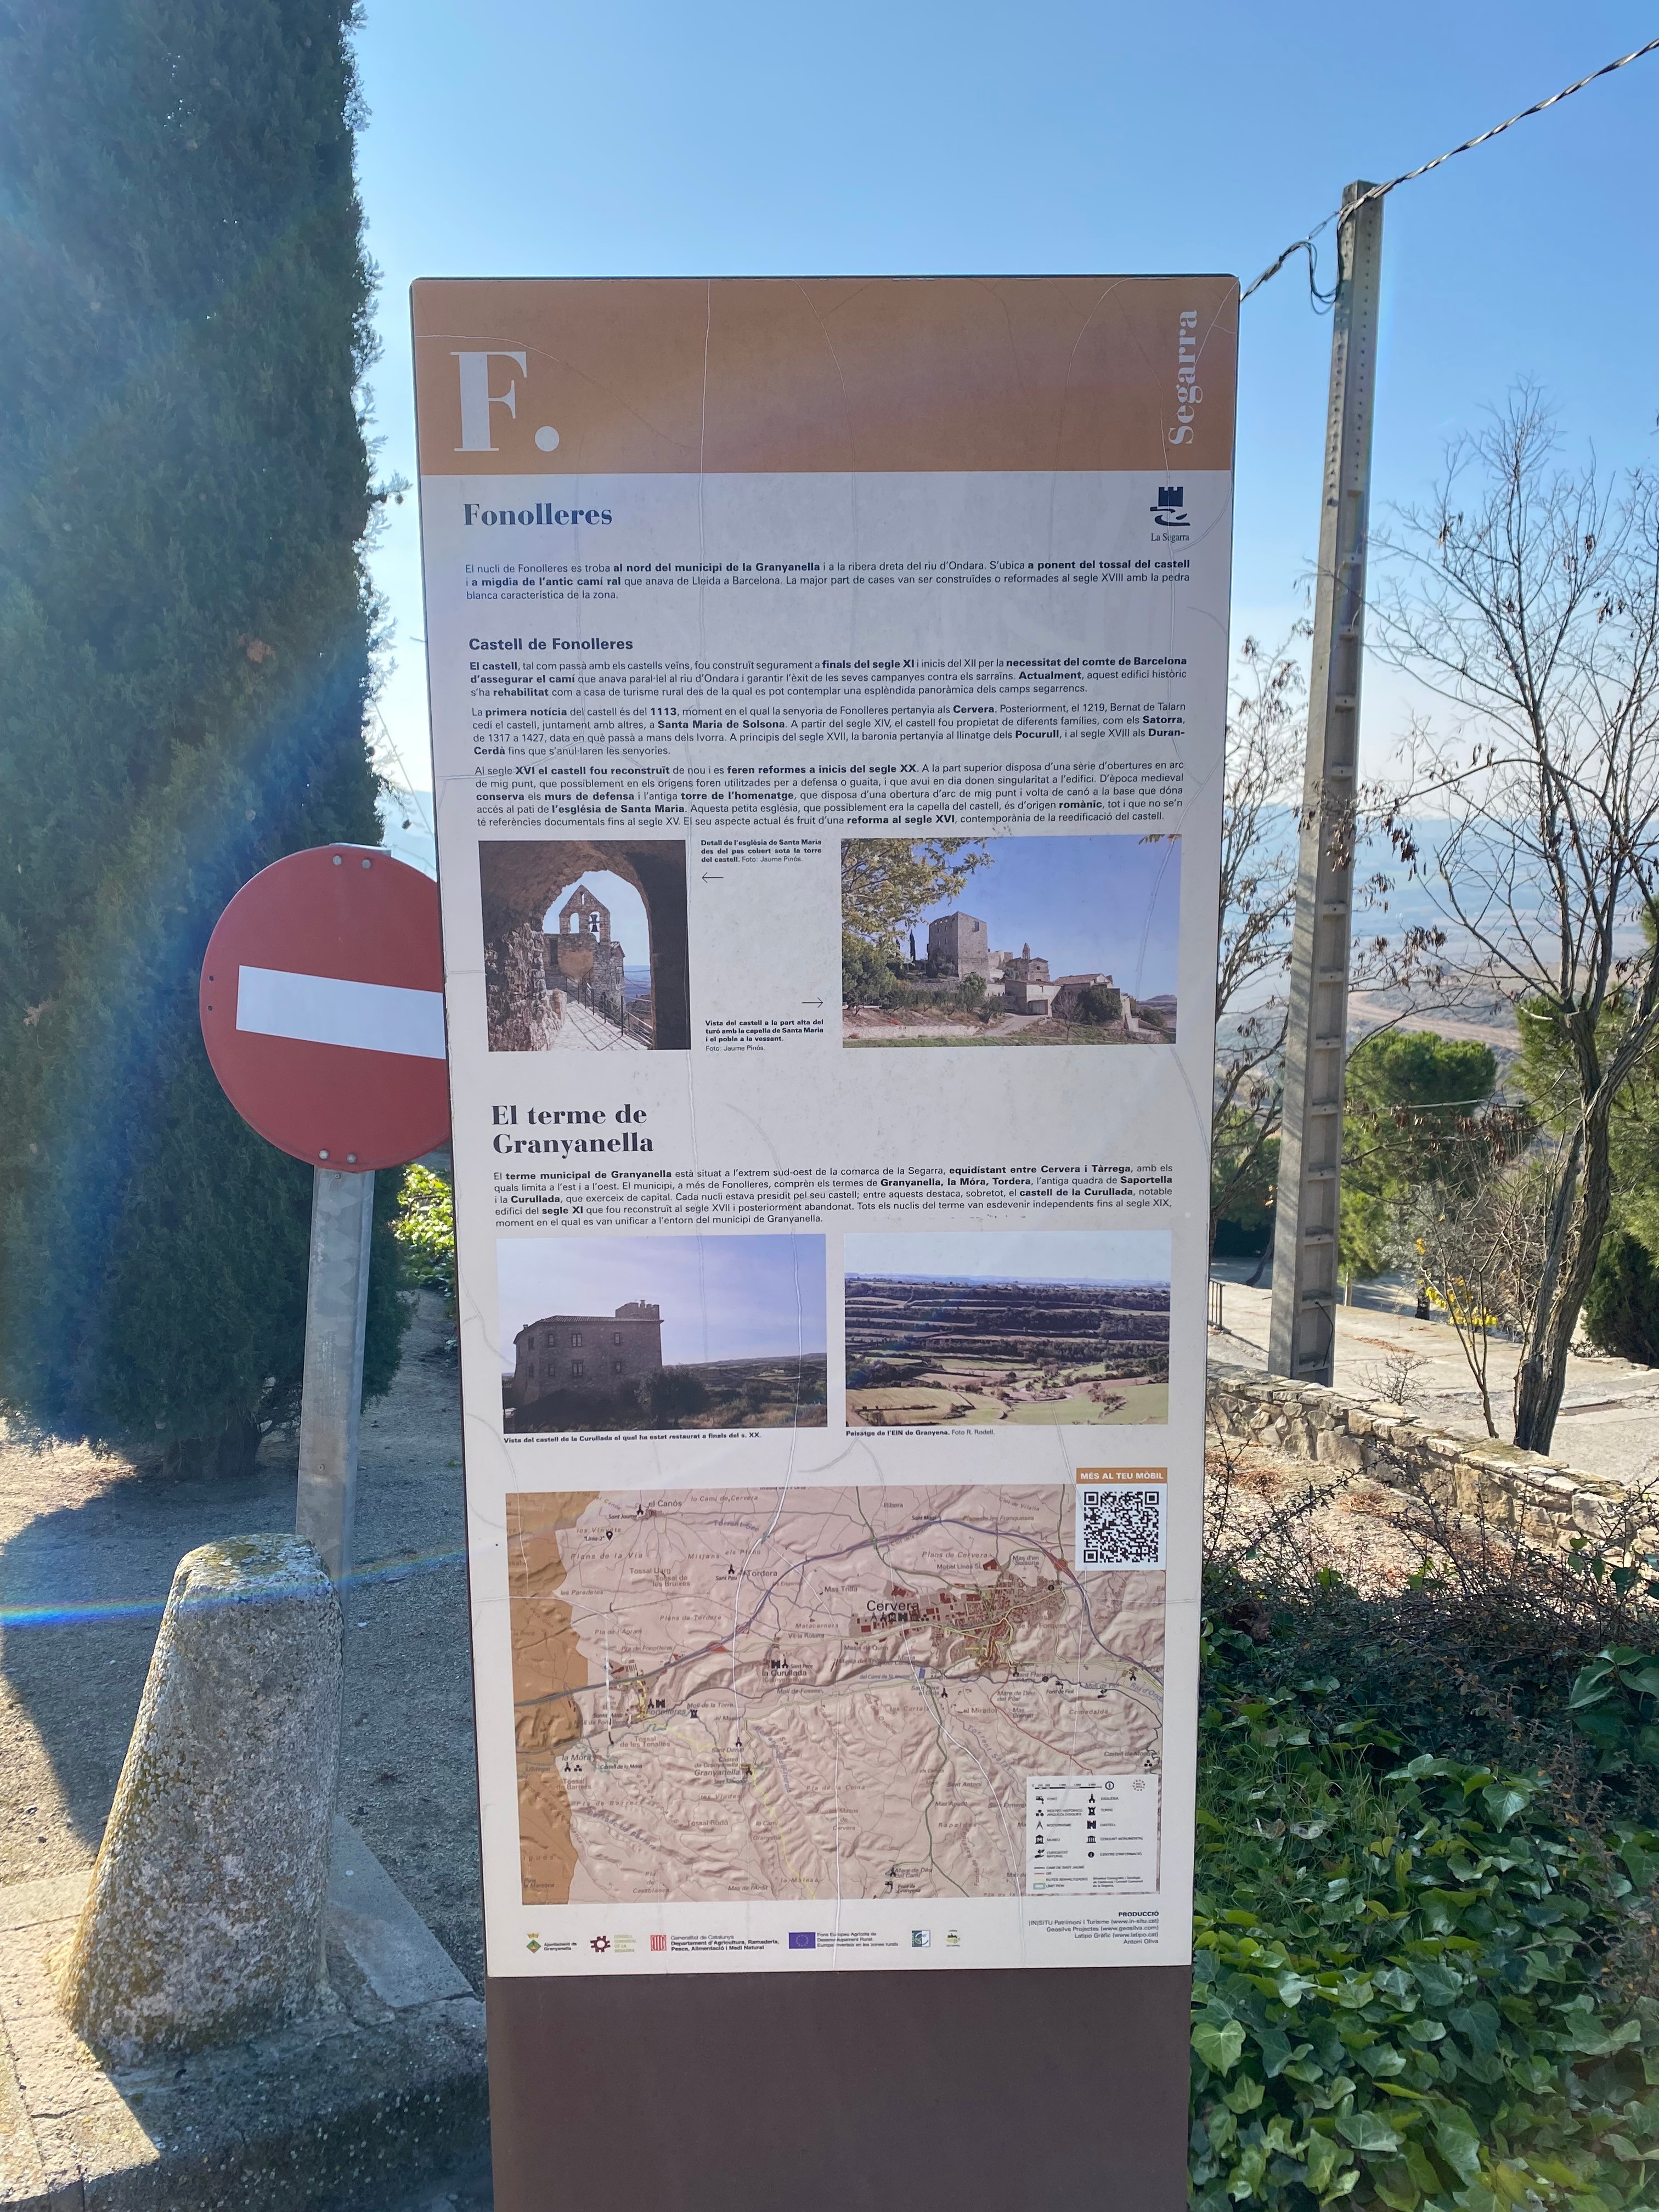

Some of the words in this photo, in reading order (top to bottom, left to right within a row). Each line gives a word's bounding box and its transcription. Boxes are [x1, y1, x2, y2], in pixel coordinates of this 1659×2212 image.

[1168, 309, 1203, 444] Segarra
[450, 351, 560, 452] F.
[463, 503, 612, 526] Fonolleres
[1151, 533, 1160, 541] La
[1163, 533, 1189, 543] Segarra
[465, 564, 474, 573] El
[477, 564, 500, 573] nucli
[503, 564, 515, 573] de
[518, 563, 568, 573] Fonolleres
[584, 563, 610, 572] troba
[613, 563, 623, 572] al
[627, 563, 652, 572] nord
[654, 563, 672, 572] del
[675, 562, 722, 574] municipi
[725, 562, 739, 572] de
[742, 562, 752, 571] la
[755, 562, 820, 573] Granyanella
[823, 562, 826, 571] i
[837, 562, 845, 571] la
[848, 561, 876, 571] ribera
[879, 561, 904, 571] dreta
[906, 561, 921, 570] del
[924, 561, 936, 570] riu
[939, 560, 986, 570] d'Ondara.
[990, 560, 1025, 570] S'ubica
[1037, 561, 1076, 571] ponent
[1079, 560, 1096, 569] del
[1098, 560, 1131, 568] tossal
[1135, 559, 1151, 568] del
[1154, 559, 1190, 568] castell
[466, 590, 498, 600] blanca
[500, 590, 564, 600] característica
[567, 590, 579, 599] de
[582, 590, 590, 599] la
[469, 637, 522, 650] Castell
[528, 637, 546, 650] de
[552, 637, 633, 650] Fonolleres
[471, 687, 490, 697] s'ha
[493, 687, 549, 696] rehabilitat
[608, 687, 620, 696] de
[623, 687, 659, 696] turisme
[662, 687, 684, 696] rural
[686, 686, 703, 696] des
[706, 687, 718, 696] de
[721, 686, 729, 696] la
[732, 686, 752, 697] qual
[769, 687, 785, 697] pot
[787, 686, 841, 697] contemplar
[864, 685, 915, 697] esplèndida
[918, 684, 974, 696] panoràmica
[977, 684, 996, 693] dels
[998, 686, 1030, 695] camps
[1032, 685, 1087, 695] segarrencs.
[473, 746, 505, 755] Cerdà
[508, 746, 526, 755] fins
[528, 748, 546, 757] que
[549, 746, 603, 755] s'anul·laren
[606, 746, 620, 755] les
[622, 746, 670, 757] senyories.
[491, 1104, 518, 1125] El
[527, 1106, 606, 1125] terme
[614, 1103, 647, 1124] de
[493, 1132, 654, 1159] Granyanella
[550, 1218, 558, 1226] el
[561, 1217, 580, 1227] qual
[614, 1216, 649, 1225] unificar
[659, 1216, 693, 1224] l'entorn
[696, 1215, 710, 1224] del
[712, 1215, 751, 1225] municipi
[753, 1215, 765, 1223] de
[767, 1214, 823, 1224] Granyanella.
[1080, 1471, 1099, 1480] MÉS
[1135, 1470, 1164, 1480] MÒBIL
[867, 1600, 919, 1611] Cervera
[762, 1668, 769, 1677] la
